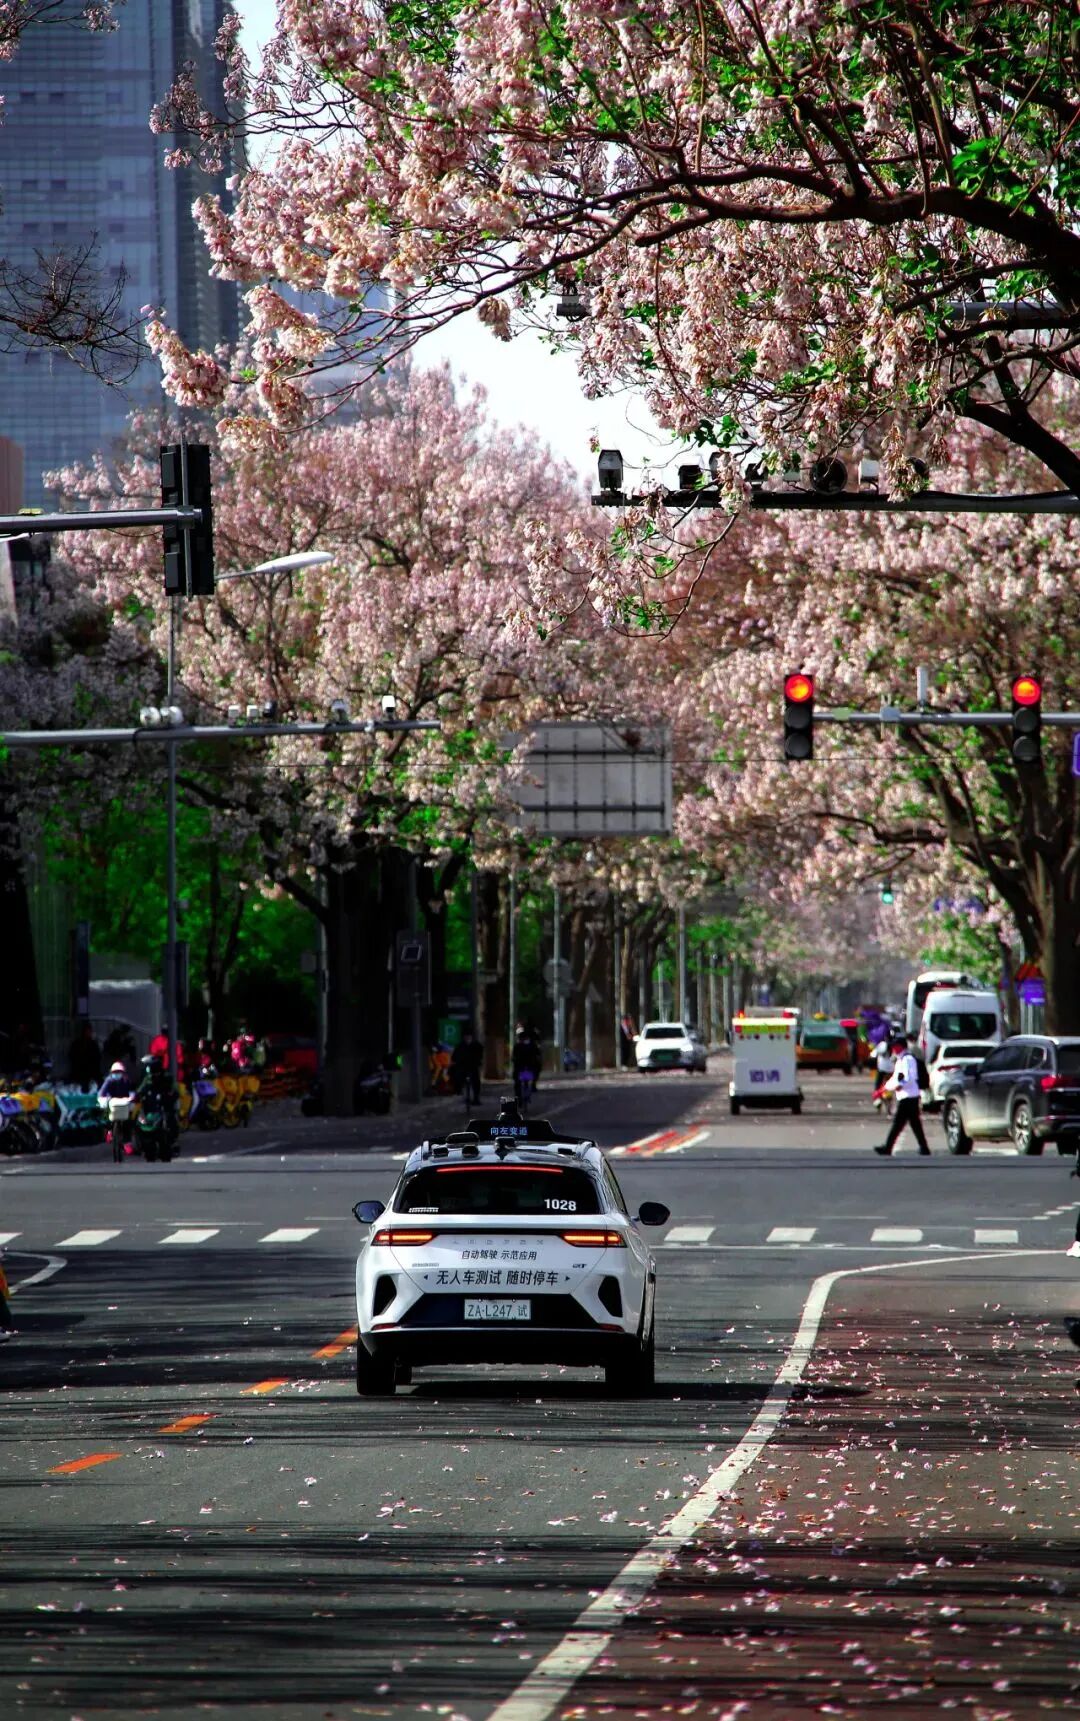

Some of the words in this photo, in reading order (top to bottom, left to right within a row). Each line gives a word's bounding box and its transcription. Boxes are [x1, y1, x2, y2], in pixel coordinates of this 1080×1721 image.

[490, 1126, 528, 1136] 向左变道
[544, 1198, 577, 1211] 1028
[461, 1249, 498, 1260] 自动驾驶
[500, 1250, 537, 1261] 示范应用
[436, 1269, 502, 1285] 无人车测试
[506, 1269, 559, 1286] 随时停车
[518, 1304, 528, 1318] 试
